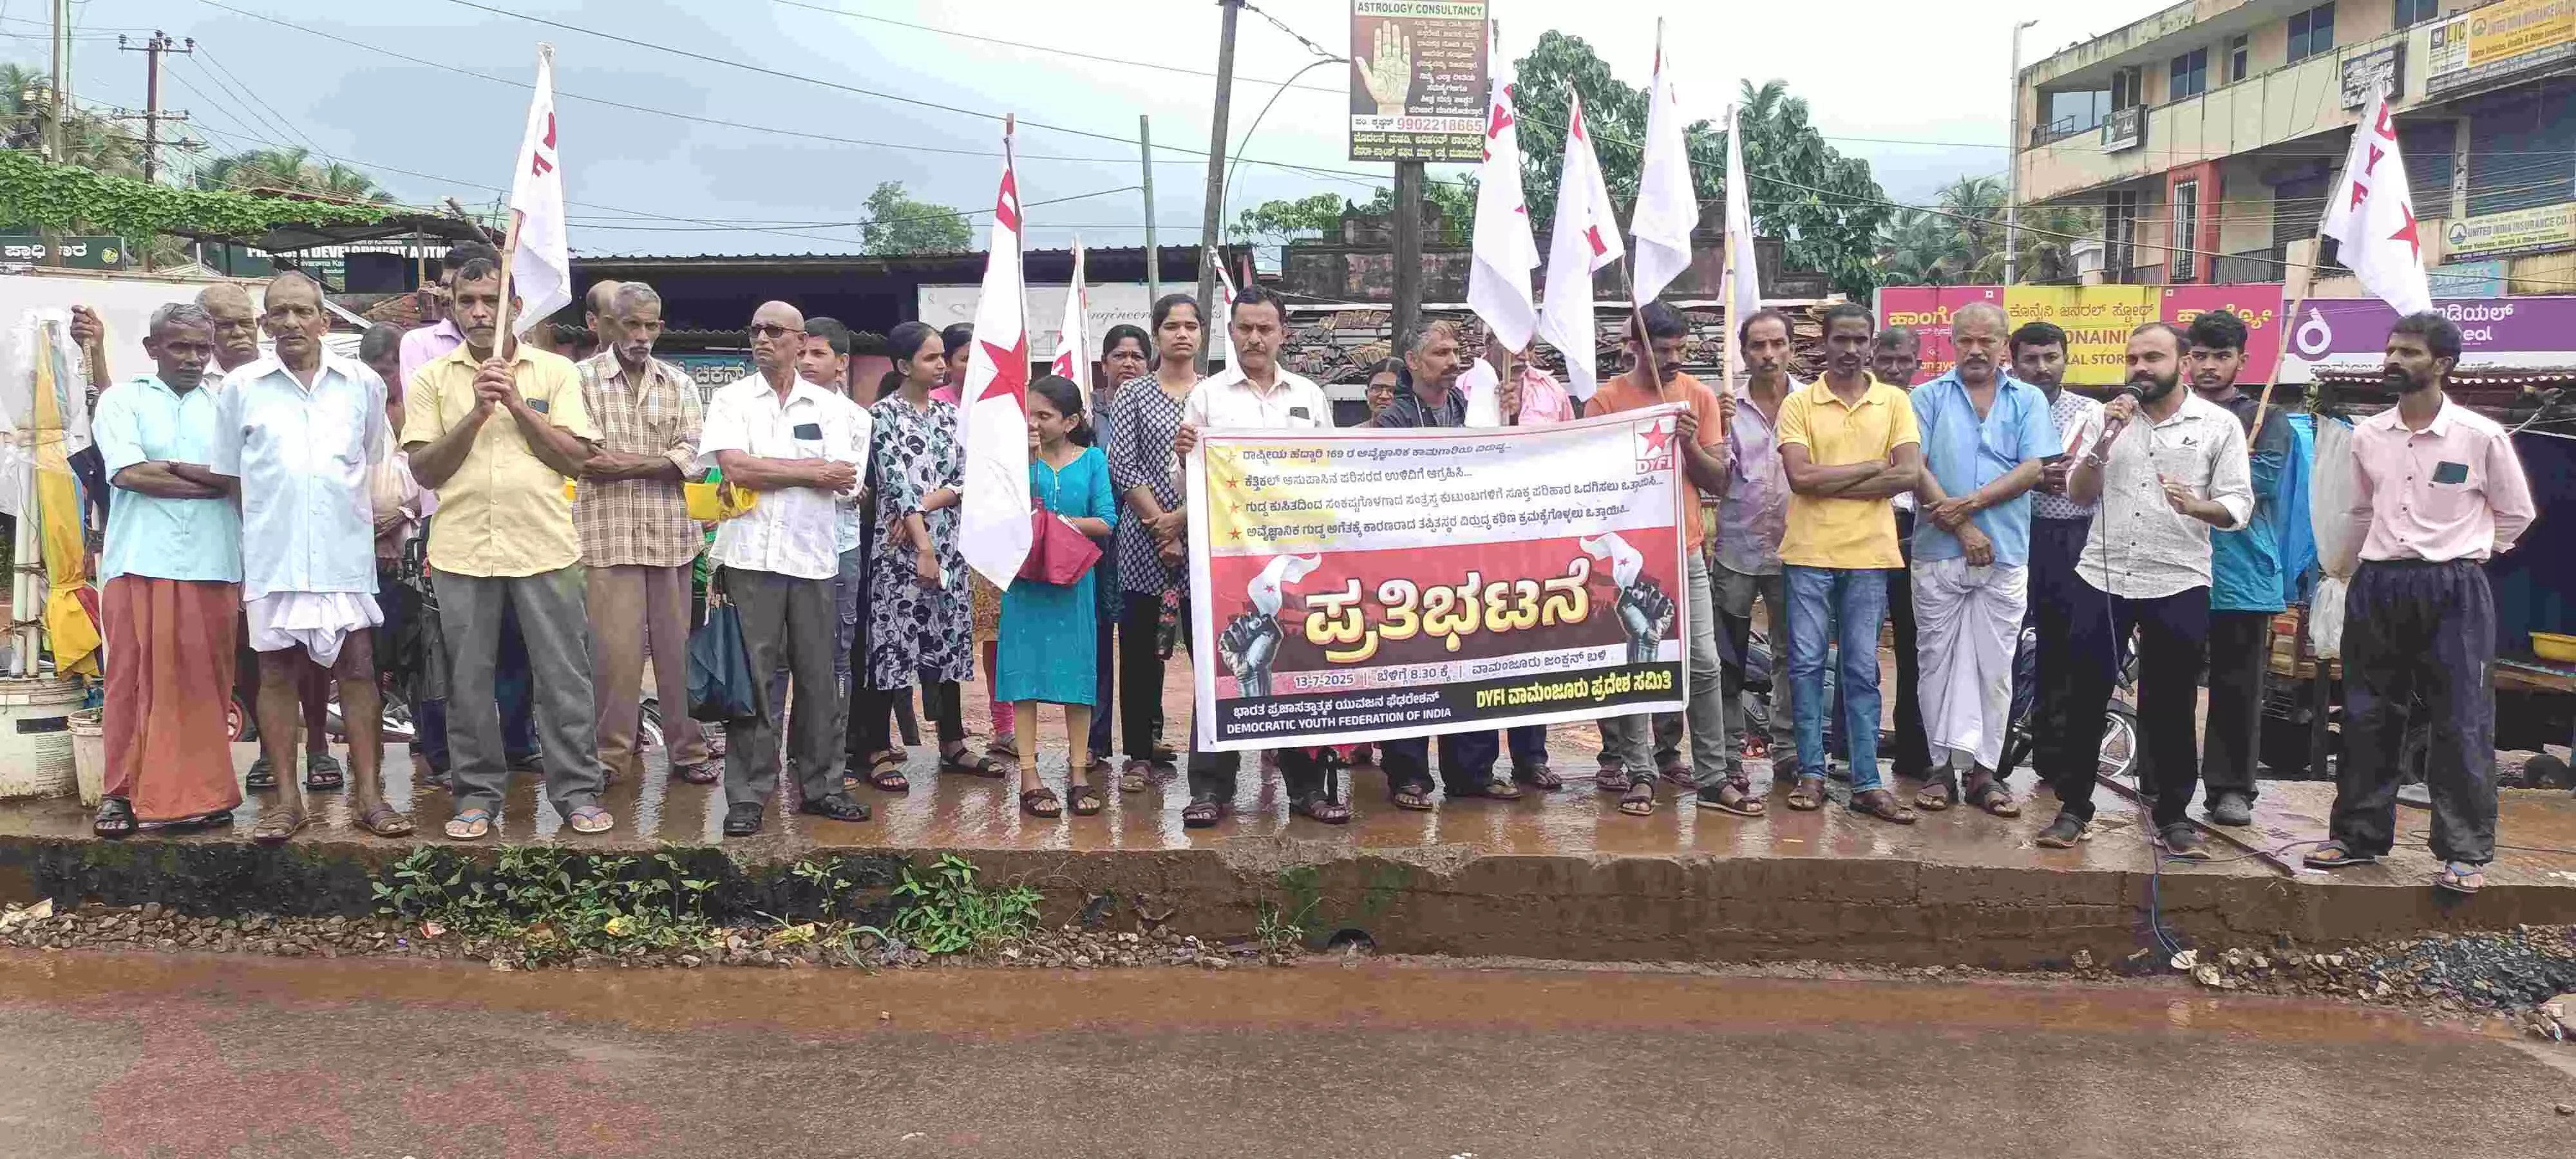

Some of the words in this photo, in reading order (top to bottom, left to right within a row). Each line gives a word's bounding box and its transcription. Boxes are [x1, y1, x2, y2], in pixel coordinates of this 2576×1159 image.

[1358, 2, 1412, 14] ASTROLOGY
[1416, 3, 1482, 16] CONSULTANCY
[2447, 22, 2466, 42] LIC
[1397, 118, 1482, 131] 9902218665
[1290, 449, 1323, 463] ಹೆದ್ದಾರಿ
[1327, 449, 1344, 458] 169
[1347, 449, 1354, 458] ರ
[1636, 457, 1669, 473] DYFI
[1340, 471, 1382, 483] ಪರಿಸರದ
[1270, 498, 1322, 512] ಕುಸಿತದಿಂದ
[1441, 487, 1502, 503] ಕುಟುಂಬಗಳಿಗೆ
[1506, 486, 1531, 502] ಸೂಕ್ತ
[1533, 484, 1571, 496] ಪರಿಹಾರ
[1574, 480, 1619, 494] ಒದಗಿಸಲು
[1247, 523, 1299, 541] ಅವೈಜ್ಞಾನಿಕ
[1364, 518, 1416, 532] ಕಾರಣರಾದ
[1304, 556, 1592, 663] ಪ್ರತಿಭಟನೆ
[1294, 674, 1354, 688] 13-7-2025
[1410, 667, 1436, 679] 8.30
[1472, 658, 1541, 675] ವಾಮಂಜೂರು
[1544, 652, 1584, 668] ಜಂಕ್ಷನ್
[1587, 649, 1607, 662] ಬಳಿ
[1476, 690, 1505, 708] DYFI
[1508, 678, 1589, 704] ವಾಮಂಜೂರು
[1591, 672, 1631, 702] ಪ್ರದೇಶ
[1633, 670, 1672, 691] ಸಮಿತಿ
[1234, 702, 1265, 718] ಭಾರತ
[1336, 695, 1383, 711] ಯುವಜನ
[1227, 721, 1296, 735] DEMOCRATIC
[1299, 717, 1336, 730] YOUTH
[1338, 712, 1404, 727] FEDERATION
[1406, 710, 1419, 721] OF
[1423, 708, 1452, 720] INDIA
